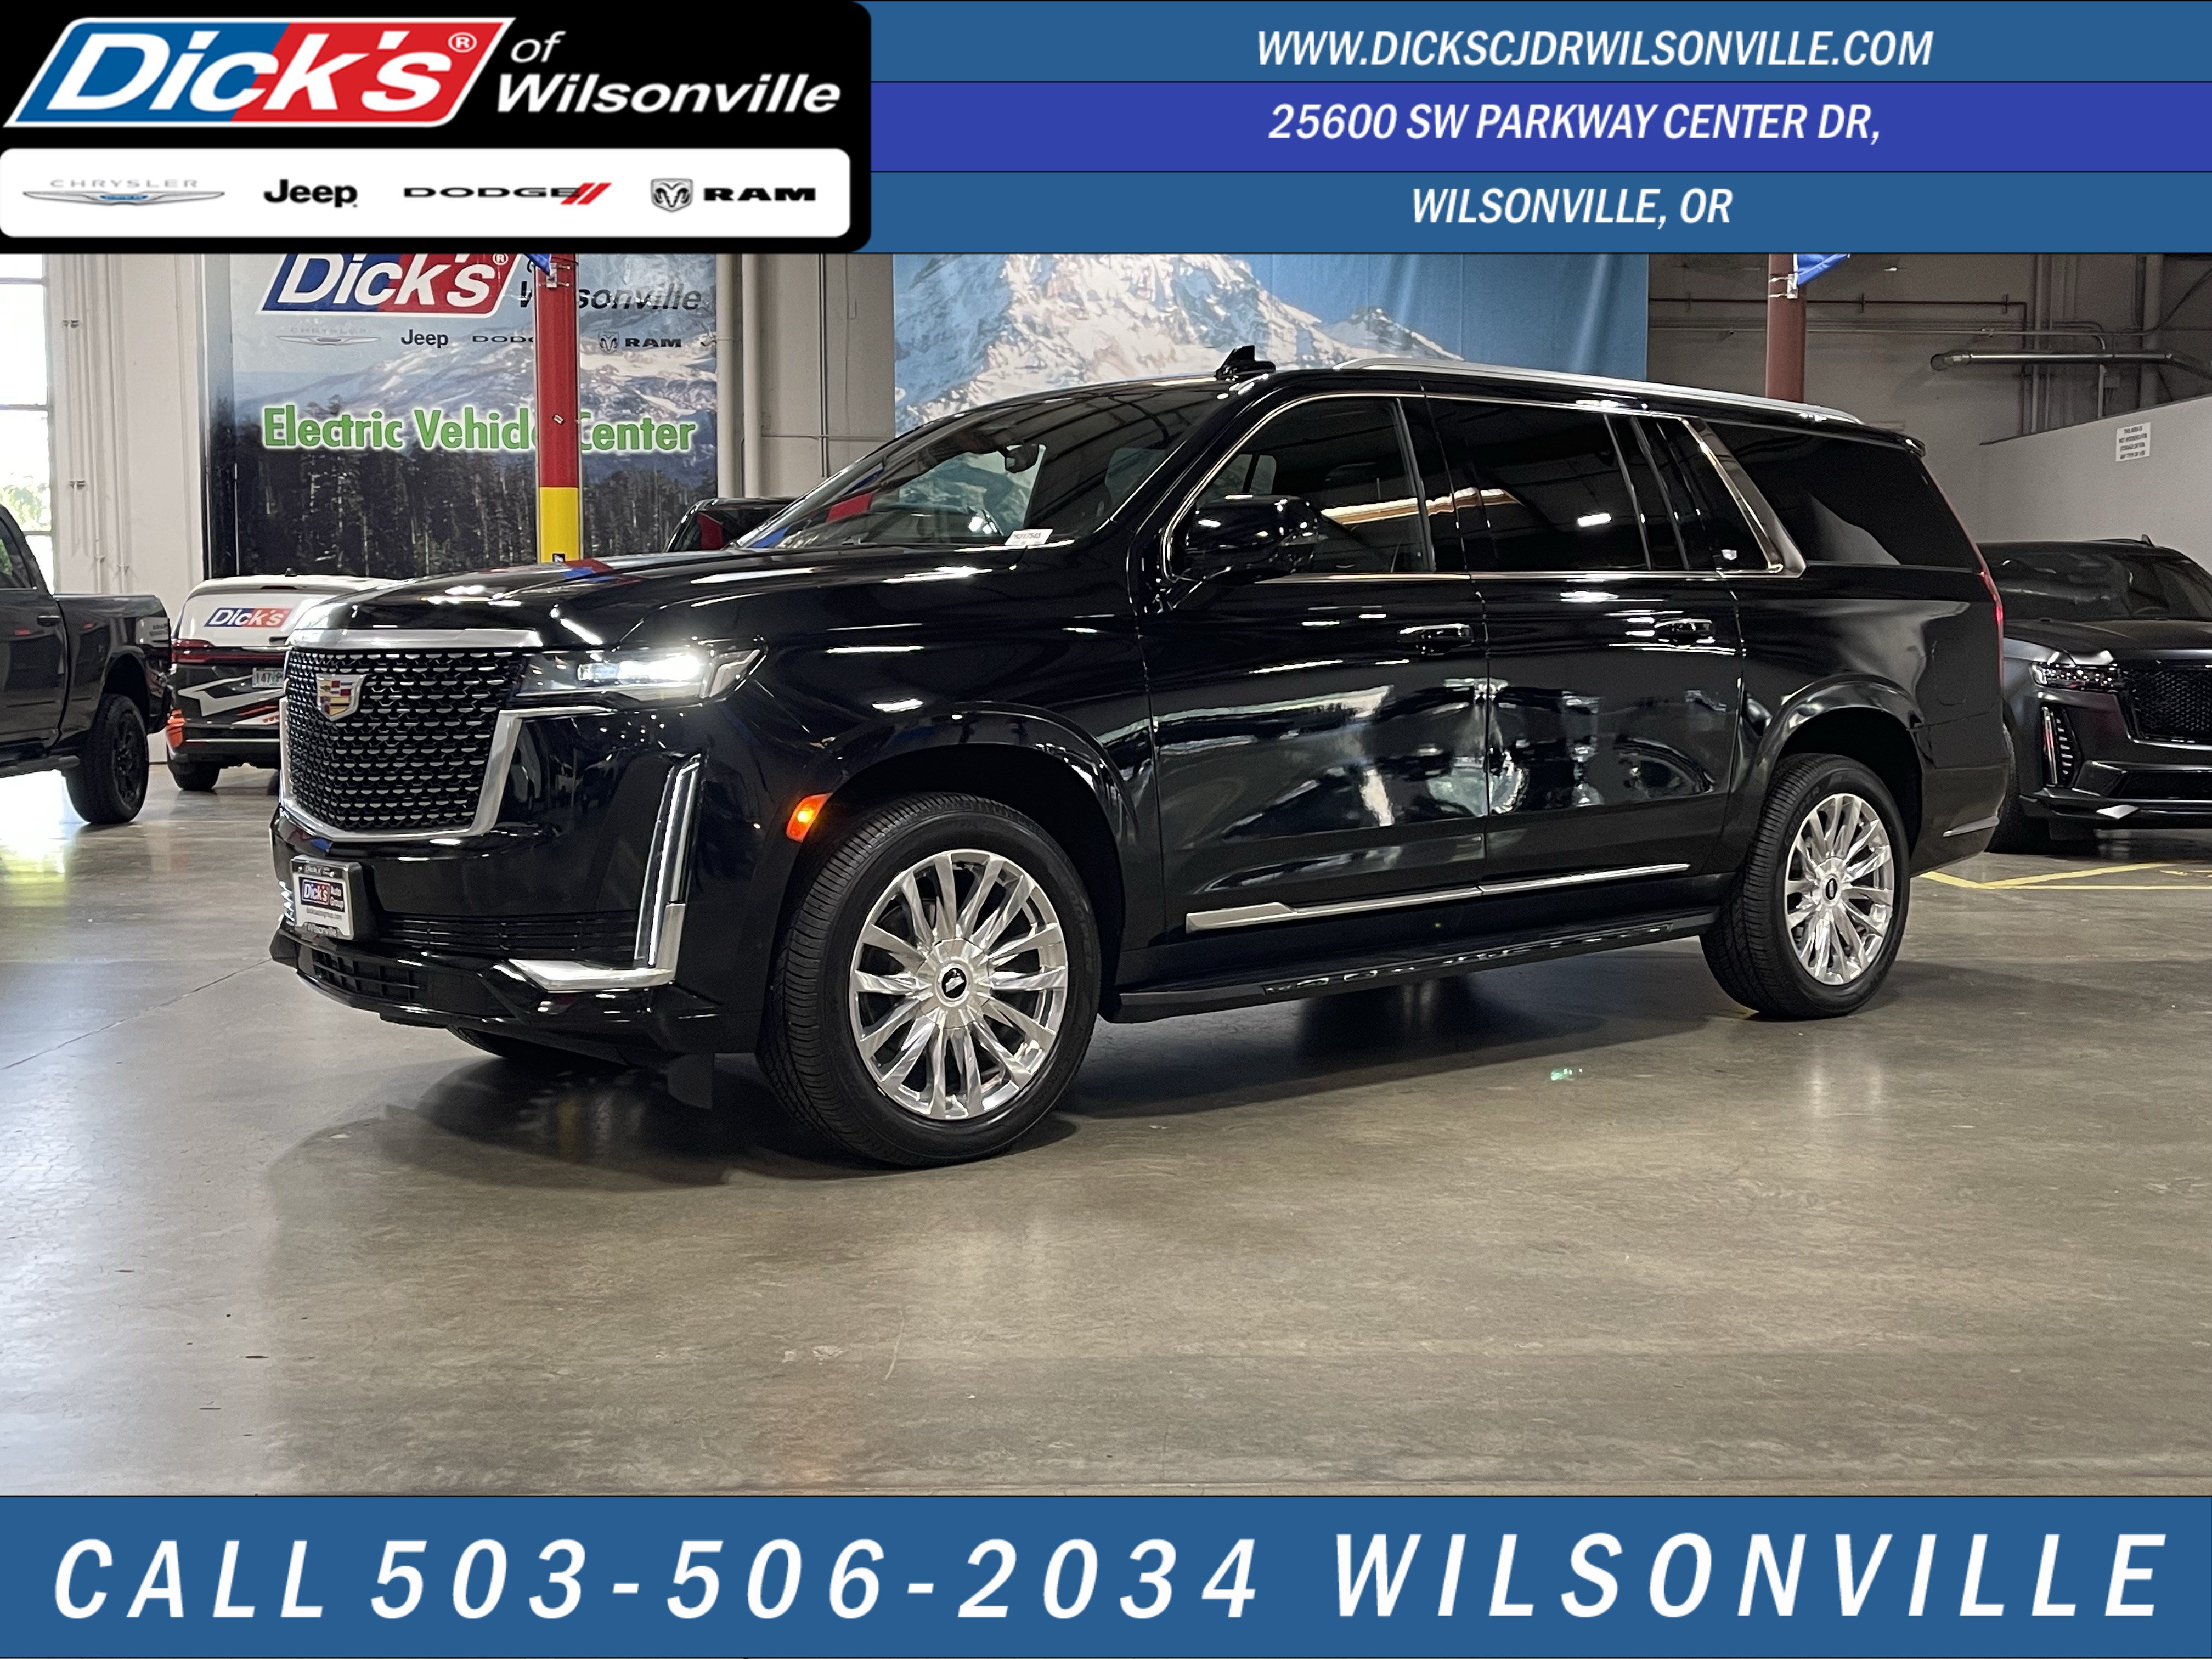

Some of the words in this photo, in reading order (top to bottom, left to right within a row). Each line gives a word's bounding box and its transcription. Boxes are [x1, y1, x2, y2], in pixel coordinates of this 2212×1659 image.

[401, 329, 449, 348] Jeep
[625, 338, 682, 347] RAM
[264, 404, 404, 449] Electric
[414, 407, 536, 449] Vehicl
[208, 609, 284, 626] Dick's
[303, 883, 329, 902] Dick's
